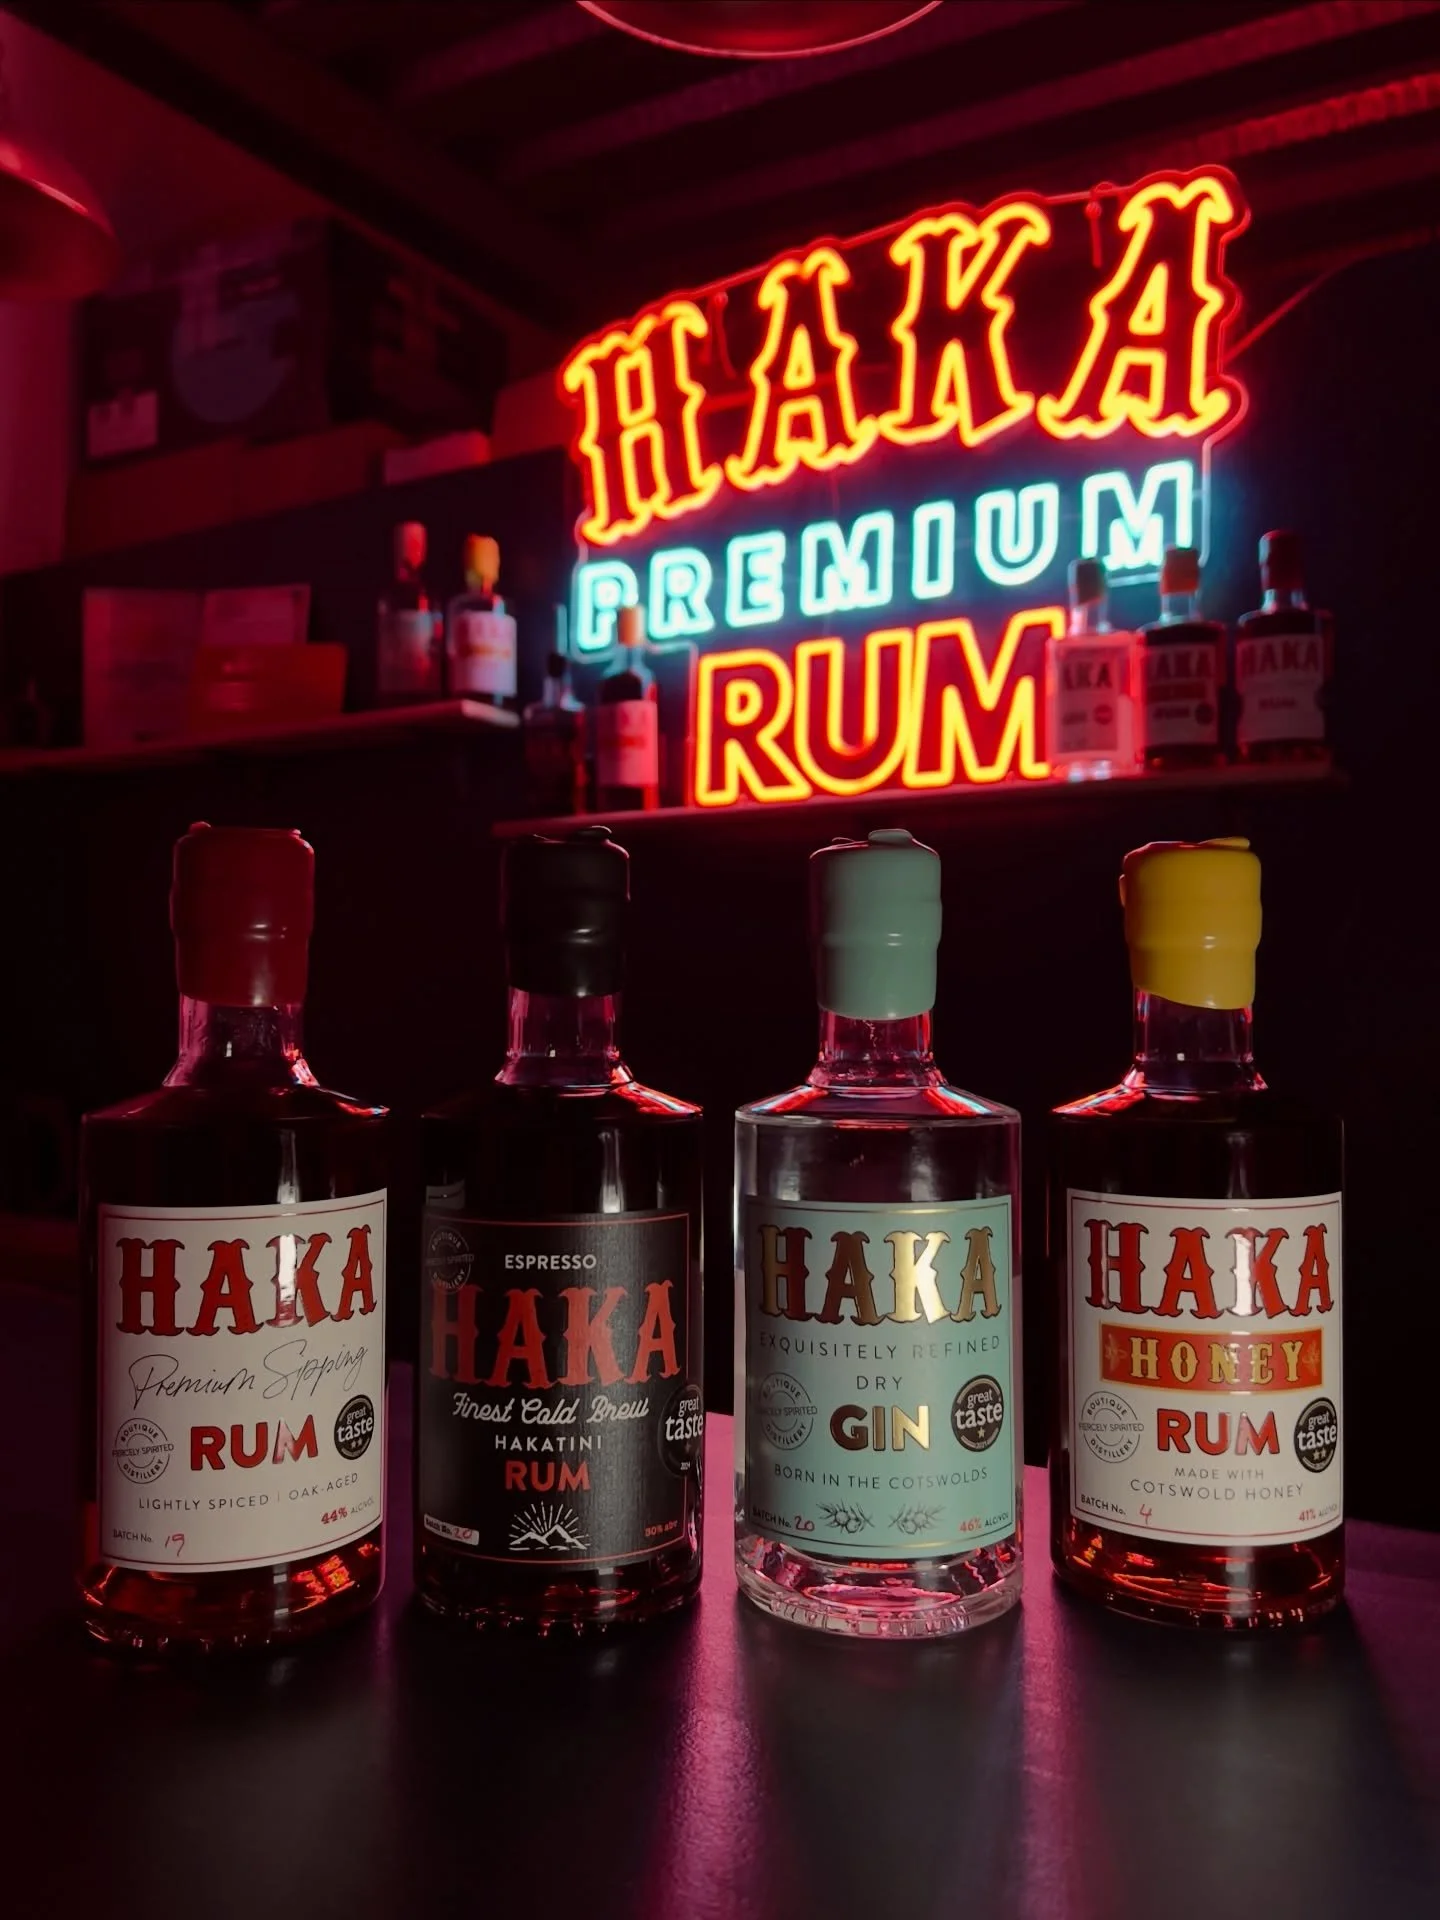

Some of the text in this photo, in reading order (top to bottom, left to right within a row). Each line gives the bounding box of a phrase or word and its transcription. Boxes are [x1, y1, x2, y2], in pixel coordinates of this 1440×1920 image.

[562, 174, 1234, 548] HAKA
[570, 458, 1195, 651] PREMIUM
[694, 606, 1067, 807] RUM
[503, 1253, 598, 1271] ESPRESSO
[758, 1223, 1002, 1326] HAKA
[1083, 1218, 1335, 1319] HAKA
[115, 1223, 378, 1336] HAKA
[428, 1279, 682, 1391] HAKA
[759, 1333, 1000, 1360] EXQUISITELY REFINED
[1129, 1335, 1304, 1385] HONEY
[128, 1338, 368, 1411] Premium Sipping
[856, 1376, 903, 1390] DRY
[452, 1391, 650, 1426] Finest Cold Brew
[678, 1396, 699, 1417] great
[783, 1405, 818, 1417] SPIRITED
[967, 1389, 993, 1409] great
[1087, 1397, 1128, 1416] BOUTIQUE
[337, 1415, 374, 1442] taste
[346, 1406, 367, 1425] great
[665, 1413, 703, 1442] taste
[829, 1404, 930, 1452] GIN
[954, 1402, 1003, 1430] taste
[1108, 1422, 1145, 1433] SPIRITED
[1308, 1411, 1330, 1431] great
[121, 1423, 159, 1442] BOUTIQUE
[190, 1413, 319, 1472] RUM
[494, 1433, 602, 1454] HAKATINI
[765, 1422, 806, 1446] DISTILLERY
[1156, 1407, 1280, 1456] RUM
[1297, 1423, 1337, 1452] taste
[141, 1443, 175, 1455] SPIRITED
[1090, 1438, 1134, 1459] DISTILLERY
[123, 1458, 164, 1480] DISTILLERY
[504, 1459, 592, 1493] RUM
[775, 1463, 987, 1490] BORN IN THE COTSWOLDS
[1174, 1467, 1264, 1480] MADE WITH
[139, 1472, 358, 1511] LIGHTLY SPICED OAK-AGED
[1129, 1479, 1304, 1500] COTSWOLD HONEY
[320, 1506, 348, 1525] 44%
[752, 1503, 777, 1525] BATCH
[794, 1515, 815, 1532] 20
[1081, 1494, 1152, 1525] BATCH No. 4
[1299, 1508, 1316, 1521] 41%
[113, 1528, 139, 1540] BATCH
[959, 1516, 982, 1534] 46%
